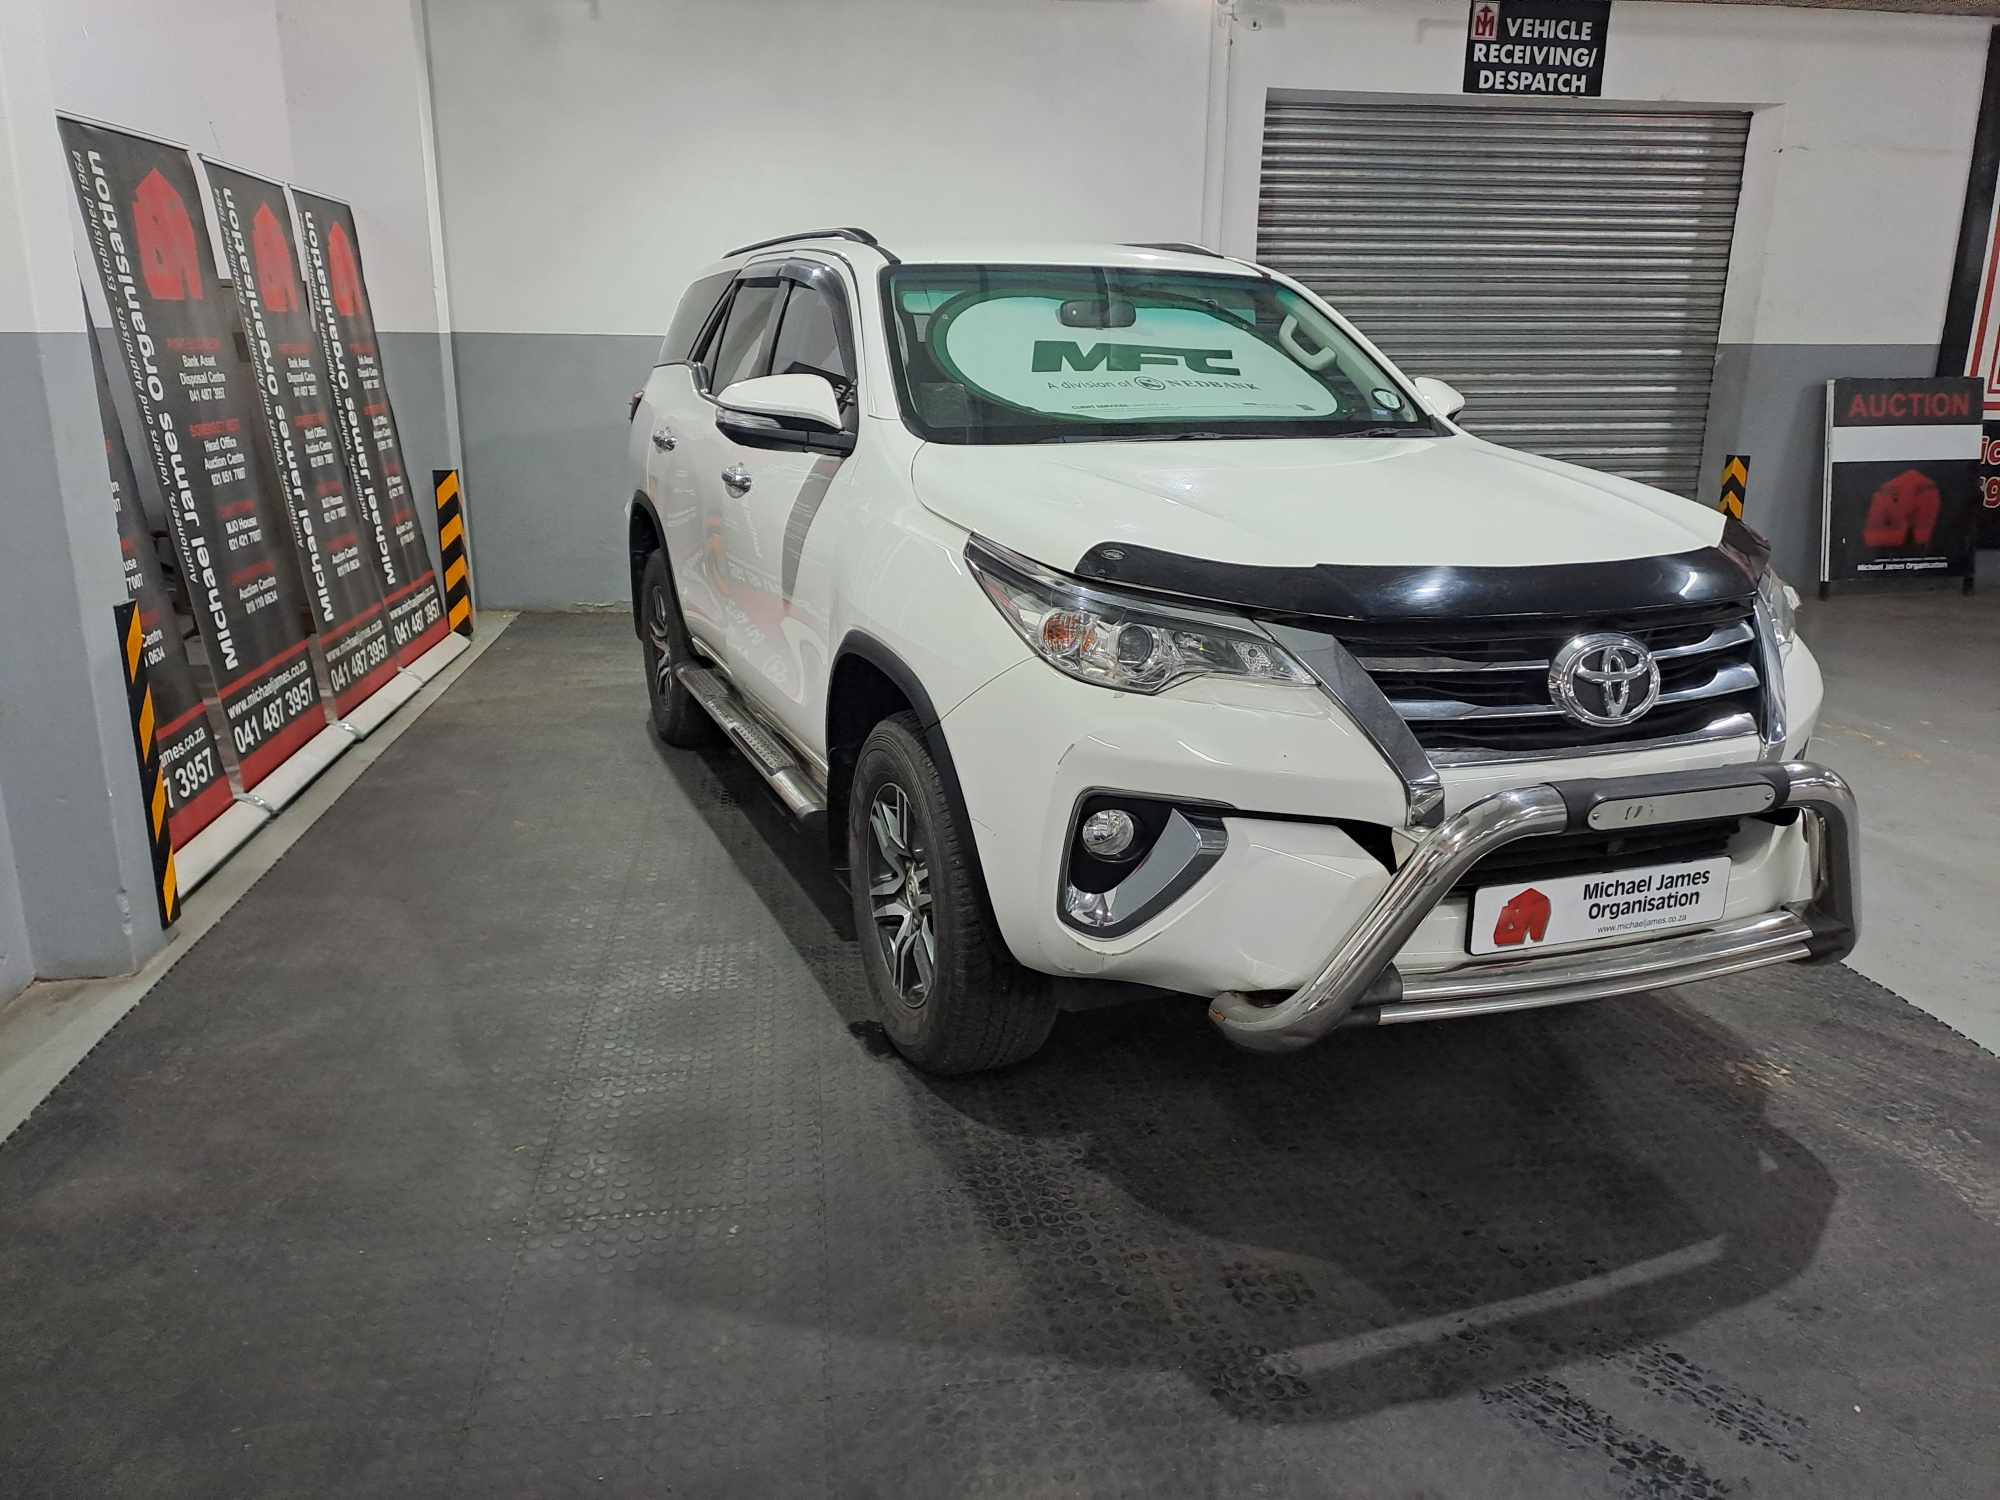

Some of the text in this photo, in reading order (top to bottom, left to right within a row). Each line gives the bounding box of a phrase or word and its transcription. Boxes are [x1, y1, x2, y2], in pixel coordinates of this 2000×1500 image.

[1473, 42, 1598, 68] RECEIVING/
[1506, 17, 1593, 41] VEHICLE
[1479, 69, 1587, 93] DESPATCH
[71, 150, 91, 192] 1964
[83, 196, 117, 292] Established
[87, 150, 164, 401] Organisation
[223, 187, 278, 395] Organisation
[304, 211, 349, 390] Organisation
[115, 305, 144, 391] Appraisers
[1031, 340, 1241, 376] MFC
[138, 394, 154, 425] and
[331, 384, 342, 407] and
[1047, 379, 1261, 391] A division of NEDBANK
[1850, 393, 1969, 417] AUCTION
[150, 430, 171, 486] Valuers
[275, 405, 305, 500] James
[345, 397, 371, 481] James
[159, 412, 200, 527] James
[168, 491, 199, 583] Auctioneers,
[364, 487, 396, 585] Michael
[298, 509, 335, 622] Michael
[190, 536, 239, 671] Michael
[393, 619, 412, 646] 041
[330, 634, 389, 692] 041 487 3957
[234, 677, 314, 753] 041 487 3957
[175, 747, 214, 798] 3957
[1583, 870, 1711, 900] Michael James
[1588, 890, 1700, 919] Organisation
[1597, 914, 1687, 933] www.michaeljames.co.za
